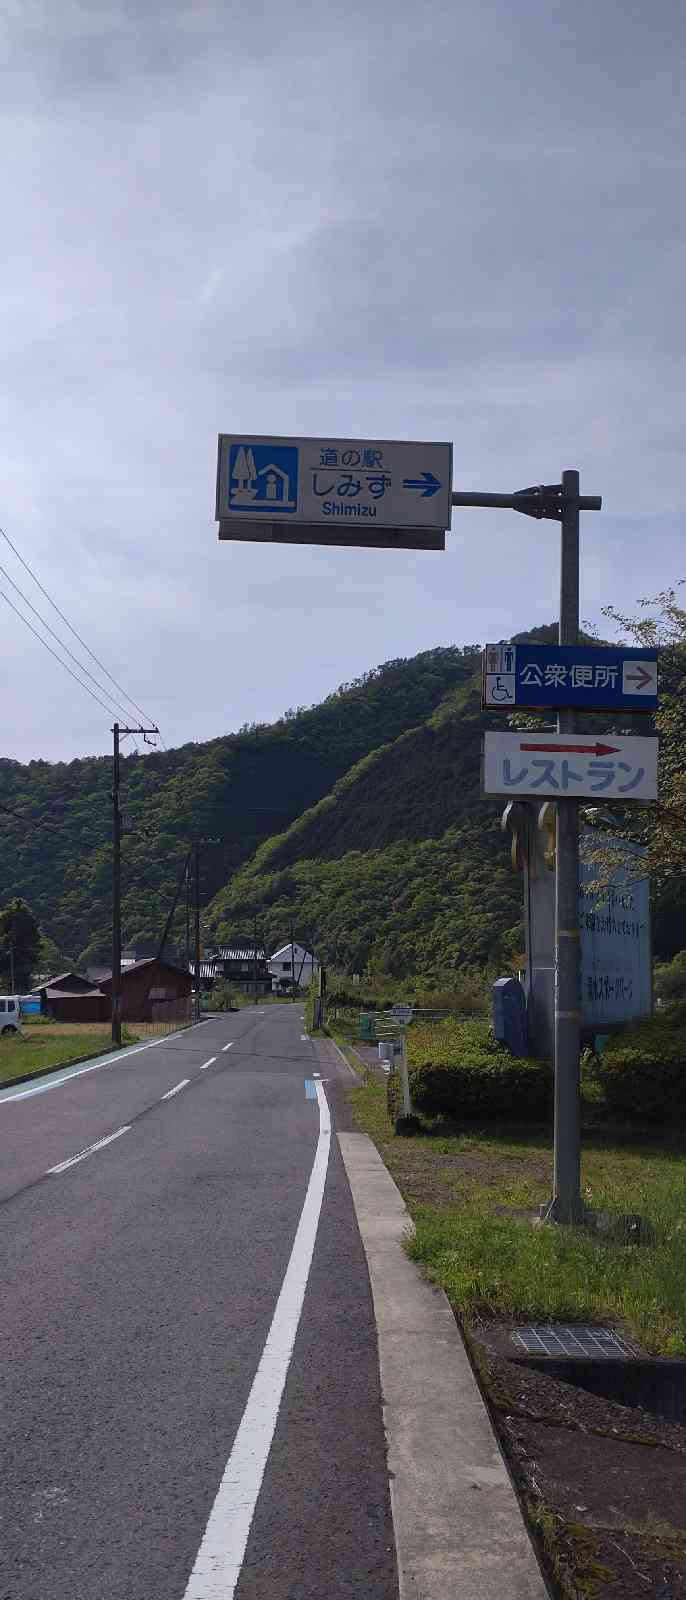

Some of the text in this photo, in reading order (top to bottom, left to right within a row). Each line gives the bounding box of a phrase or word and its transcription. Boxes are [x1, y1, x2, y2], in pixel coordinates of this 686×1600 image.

[319, 448, 384, 468] 道の駅
[312, 473, 392, 500] しみず
[321, 502, 377, 517] Shimizu
[519, 663, 619, 689] 公衆便所
[503, 758, 645, 793] レストラン
